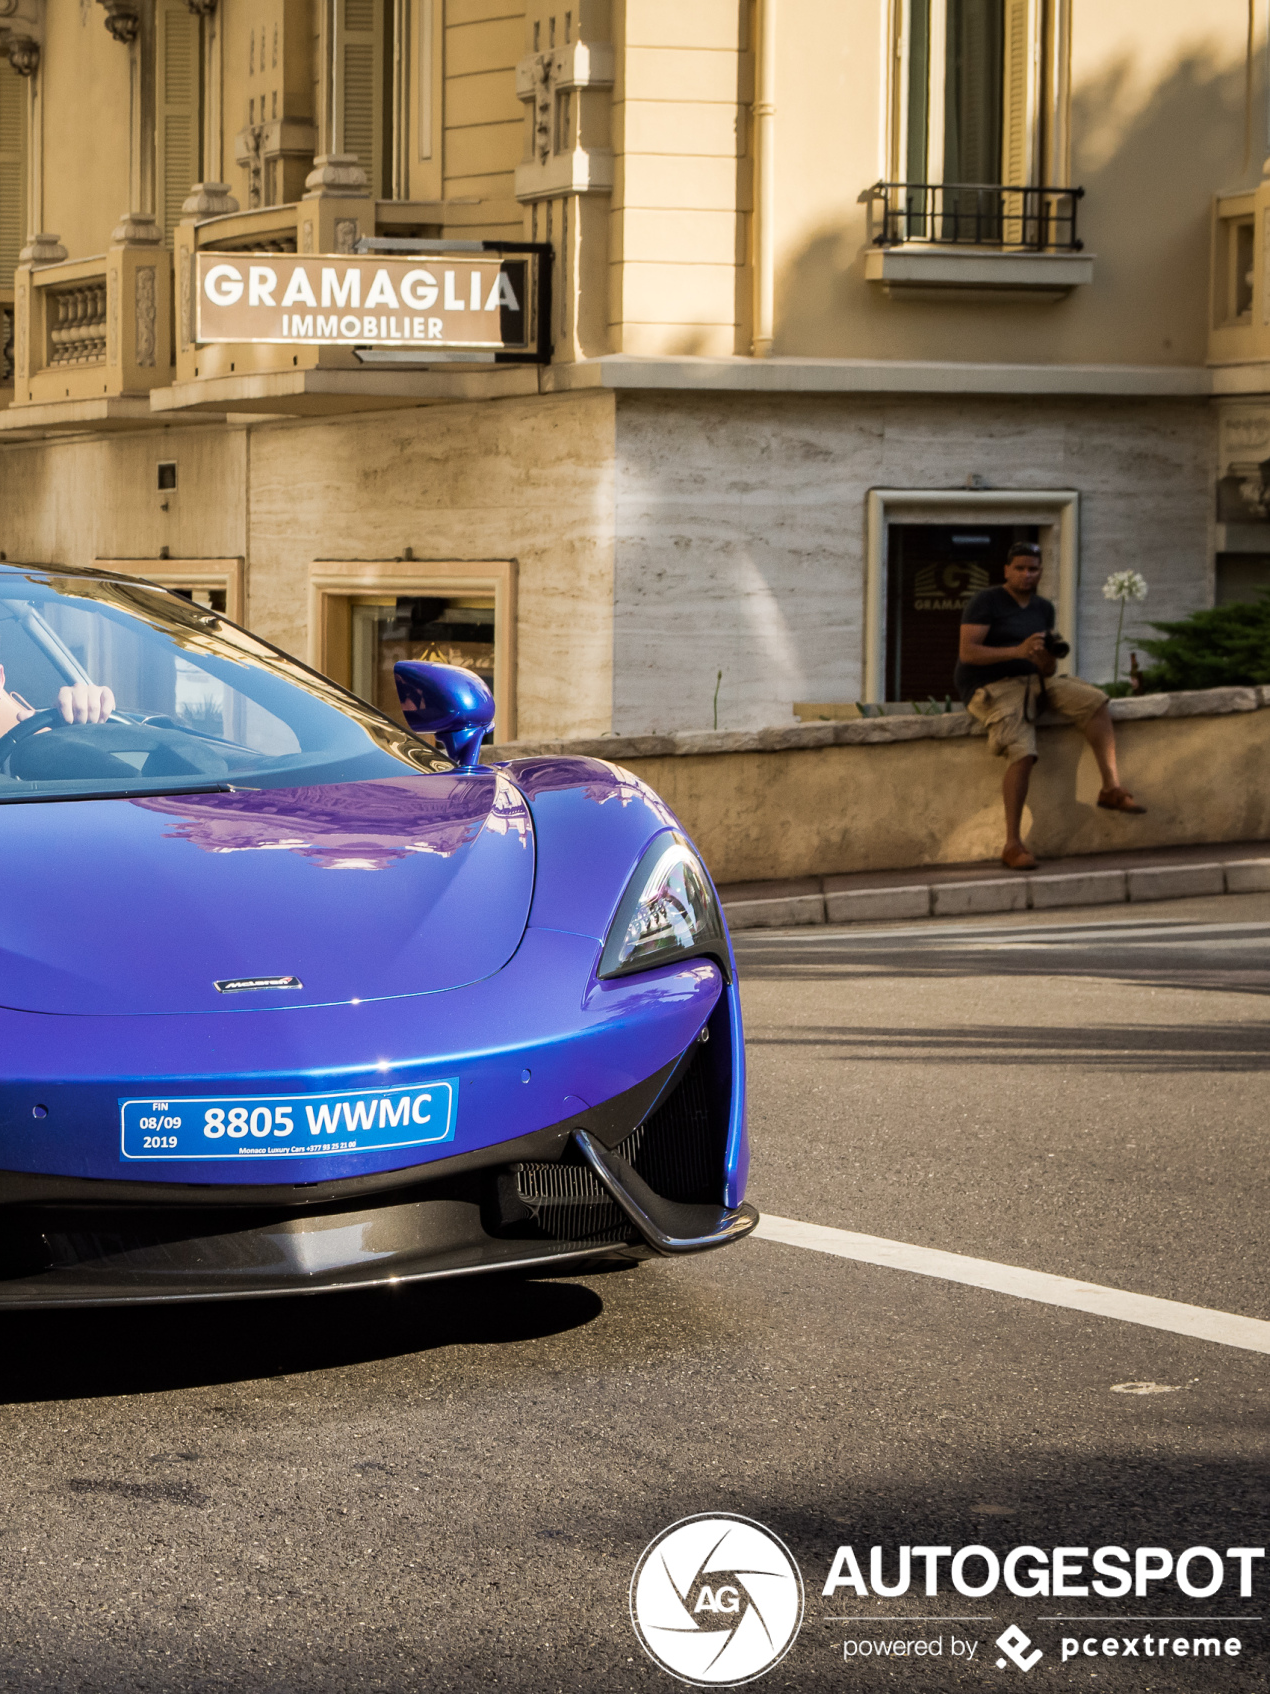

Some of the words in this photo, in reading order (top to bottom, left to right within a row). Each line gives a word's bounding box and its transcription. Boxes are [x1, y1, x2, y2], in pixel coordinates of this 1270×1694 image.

[204, 263, 520, 312] GRAMAGLIA
[282, 314, 443, 339] IMMOBILIER
[152, 1102, 169, 1111] FIN
[139, 1116, 182, 1131] 08/09
[203, 1106, 294, 1139] 8805
[305, 1093, 432, 1136] WWMC
[143, 1136, 178, 1149] 2019
[267, 1146, 291, 1154] Luxury
[291, 1145, 306, 1153] Cars
[306, 1144, 322, 1152] +377
